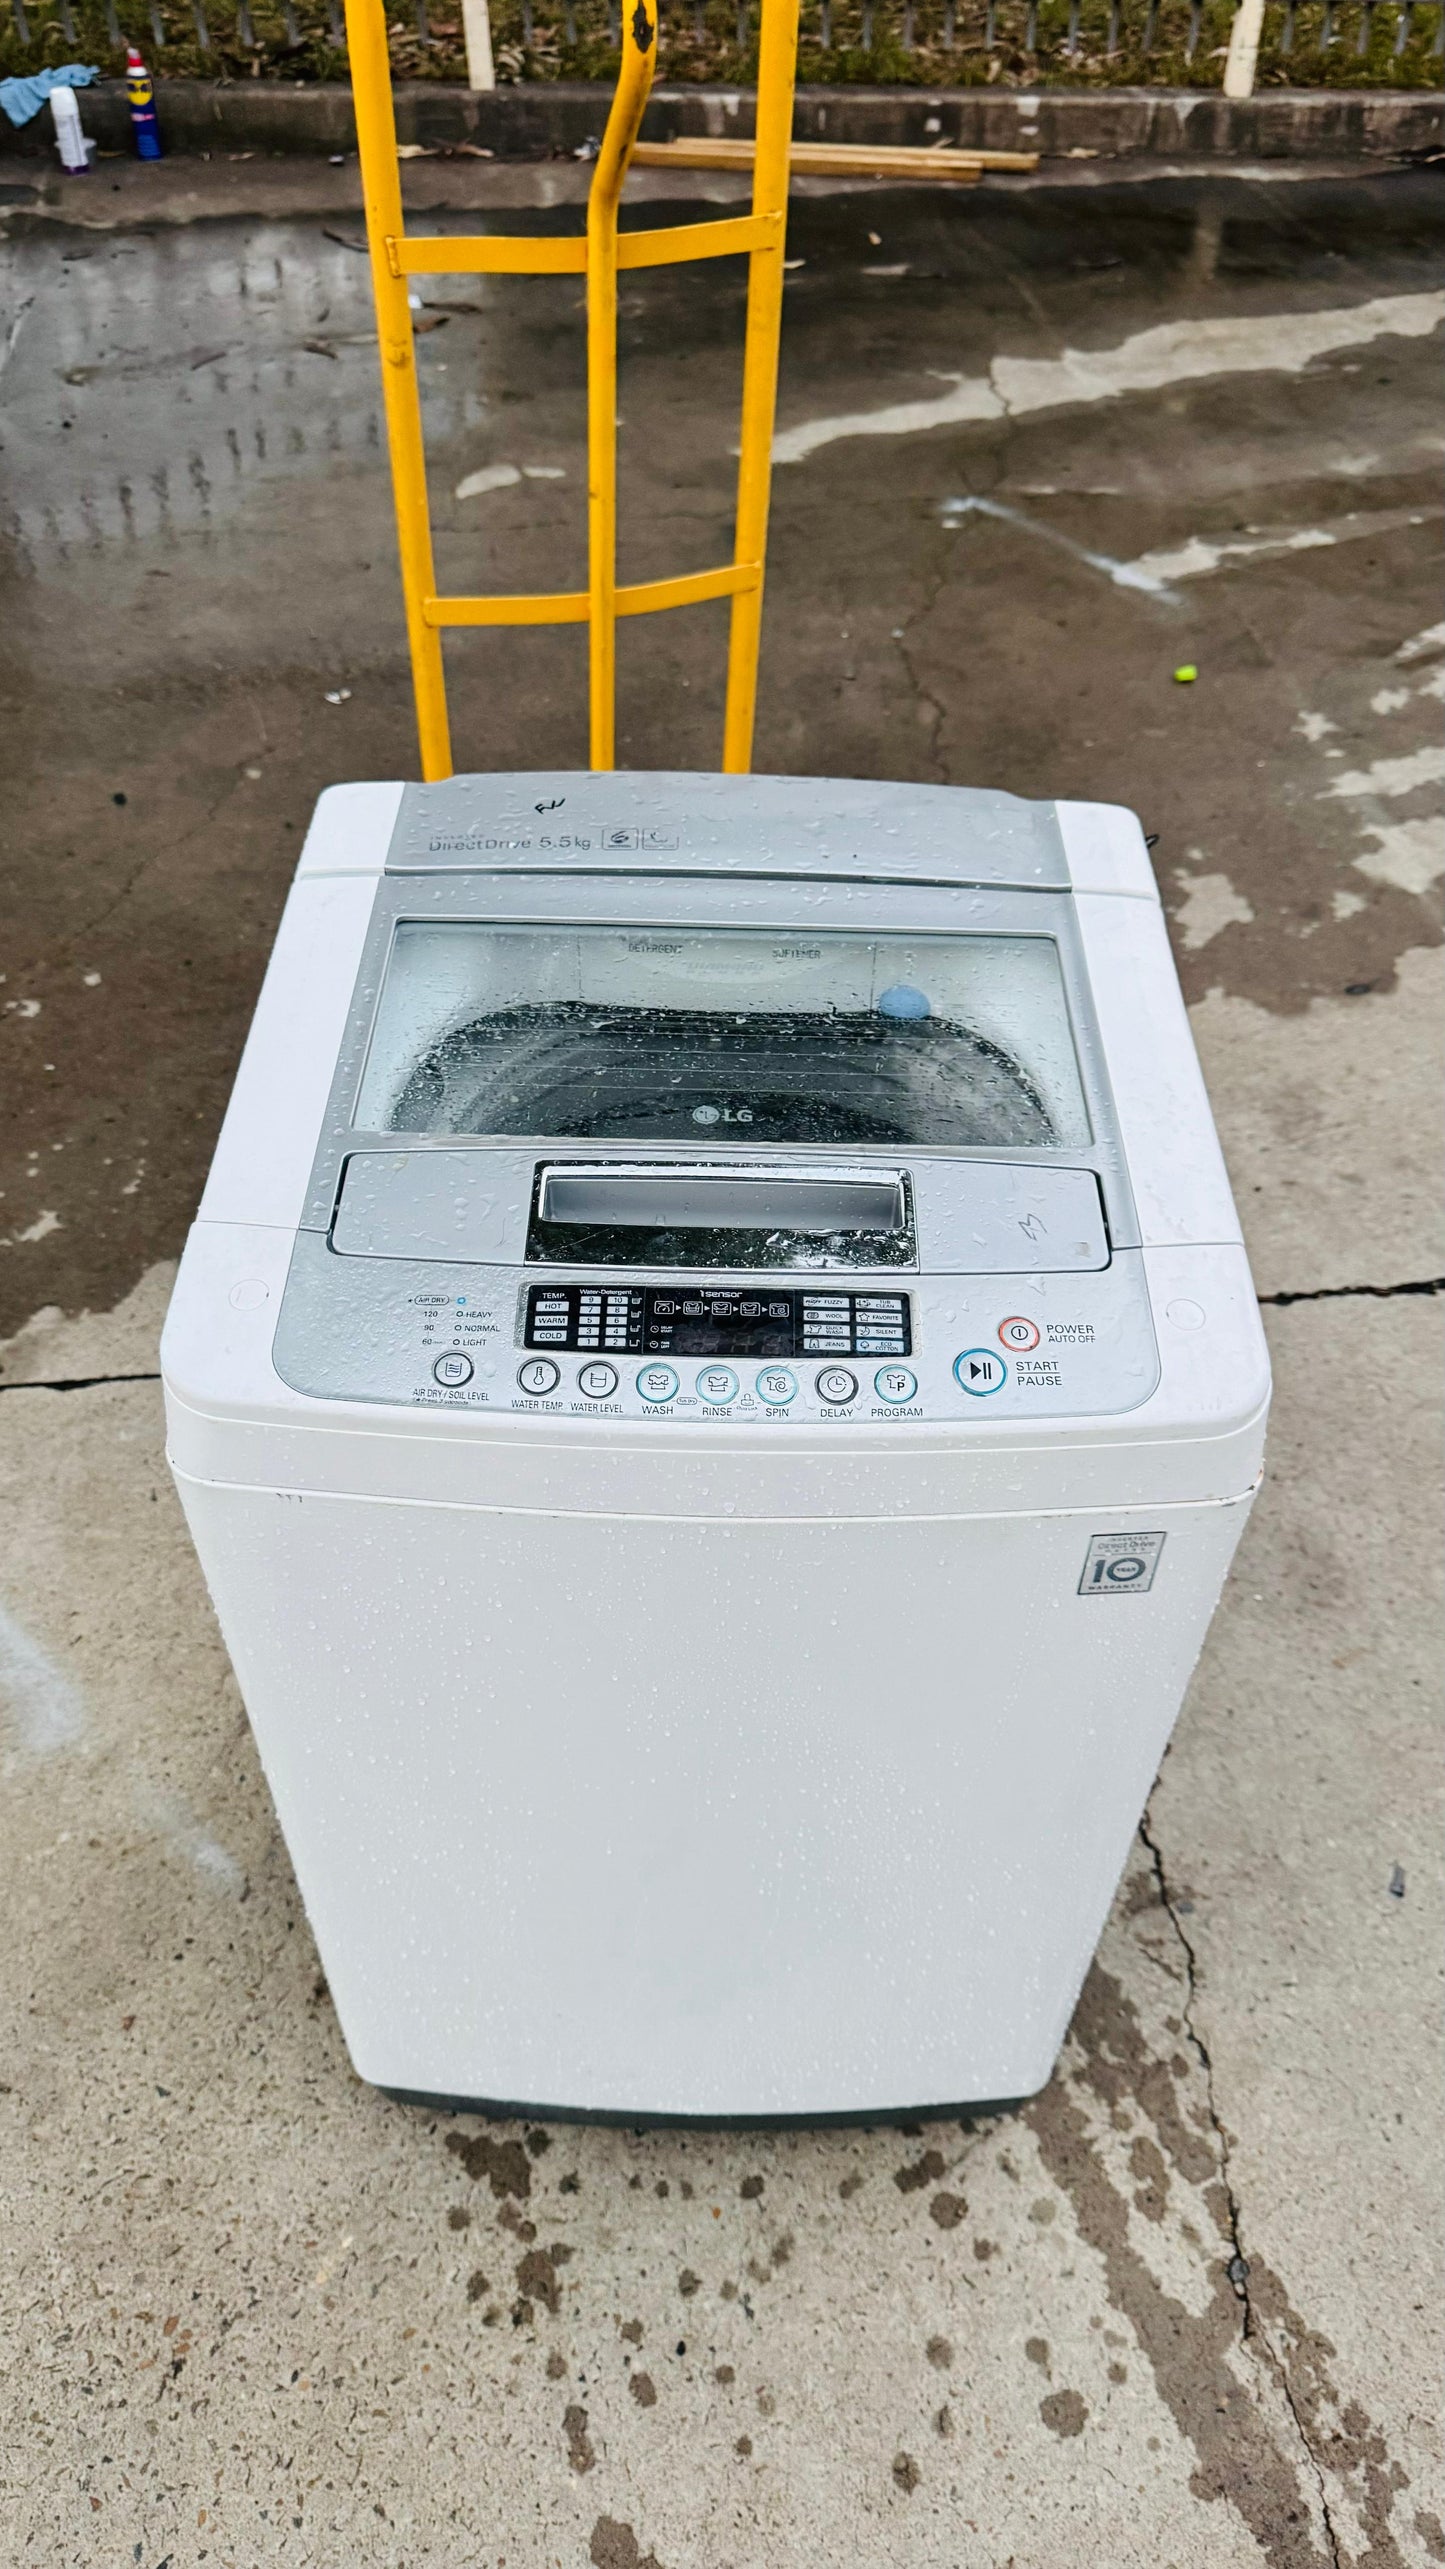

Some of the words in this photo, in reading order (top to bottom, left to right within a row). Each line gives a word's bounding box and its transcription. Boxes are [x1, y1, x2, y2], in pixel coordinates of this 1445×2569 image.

[539, 836, 572, 848] 5.5
[575, 836, 591, 850] kg
[722, 1108, 753, 1122] LG
[1046, 1325, 1095, 1334] POWER
[1048, 1335, 1075, 1343] AUTO
[1078, 1335, 1096, 1343] OFF
[1016, 1361, 1060, 1371] START
[1017, 1376, 1063, 1386] PAUSE
[897, 1381, 905, 1392] P
[413, 1388, 425, 1397] AIR
[448, 1390, 466, 1399] SOIL
[468, 1392, 490, 1401] LEVEL
[511, 1400, 539, 1409] WATER
[570, 1402, 598, 1412] WATER
[600, 1404, 624, 1413] LEVEL
[641, 1406, 674, 1414] WASH
[702, 1407, 733, 1416] RINSE
[765, 1408, 789, 1417] SPIN
[820, 1408, 854, 1417] DELAY
[871, 1407, 923, 1417] PROGRAM
[1093, 1558, 1146, 1583] 10
